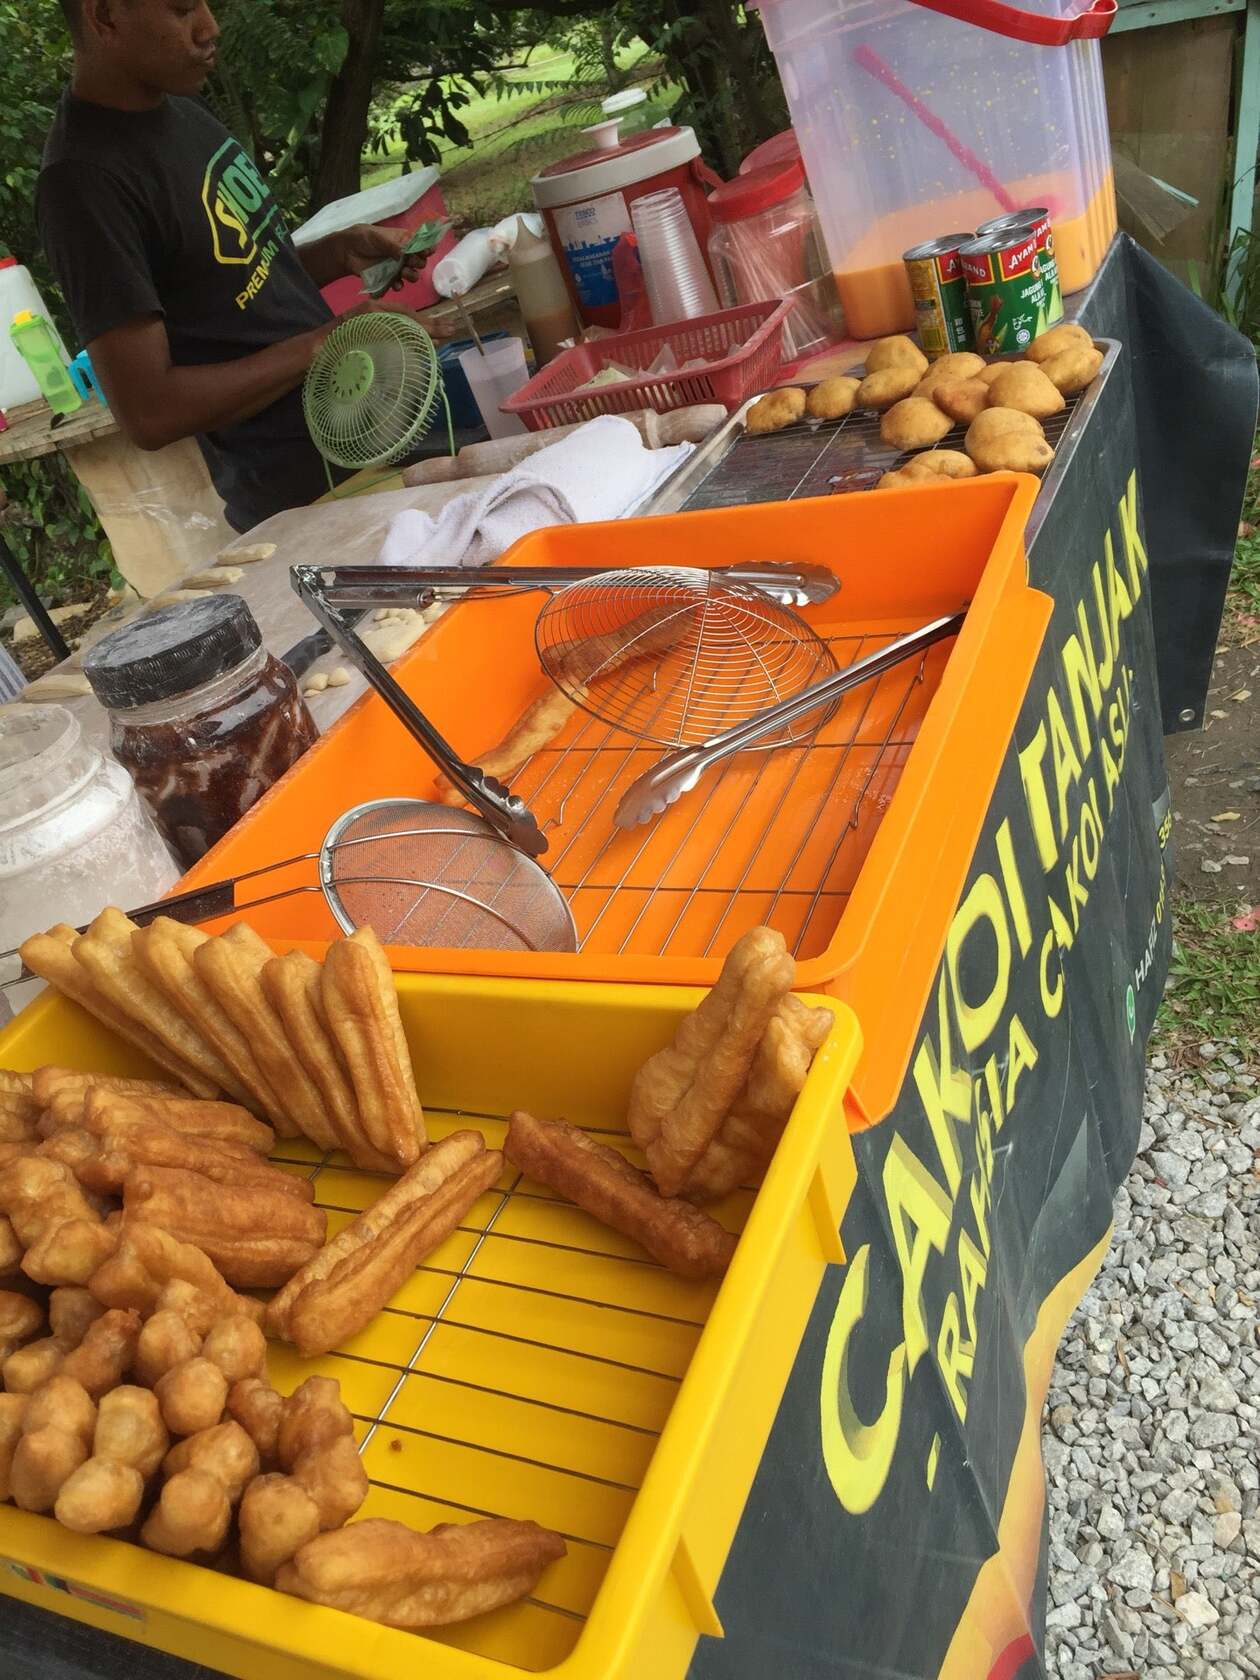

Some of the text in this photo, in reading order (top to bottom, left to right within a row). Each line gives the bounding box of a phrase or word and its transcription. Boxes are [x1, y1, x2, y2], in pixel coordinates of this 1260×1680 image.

[235, 239, 280, 310] PREMUM
[820, 468, 1148, 1515] CAKOI TANJAK
[937, 1013, 1039, 1426] RAHSIA
[1039, 777, 1104, 1019] CAKOI
